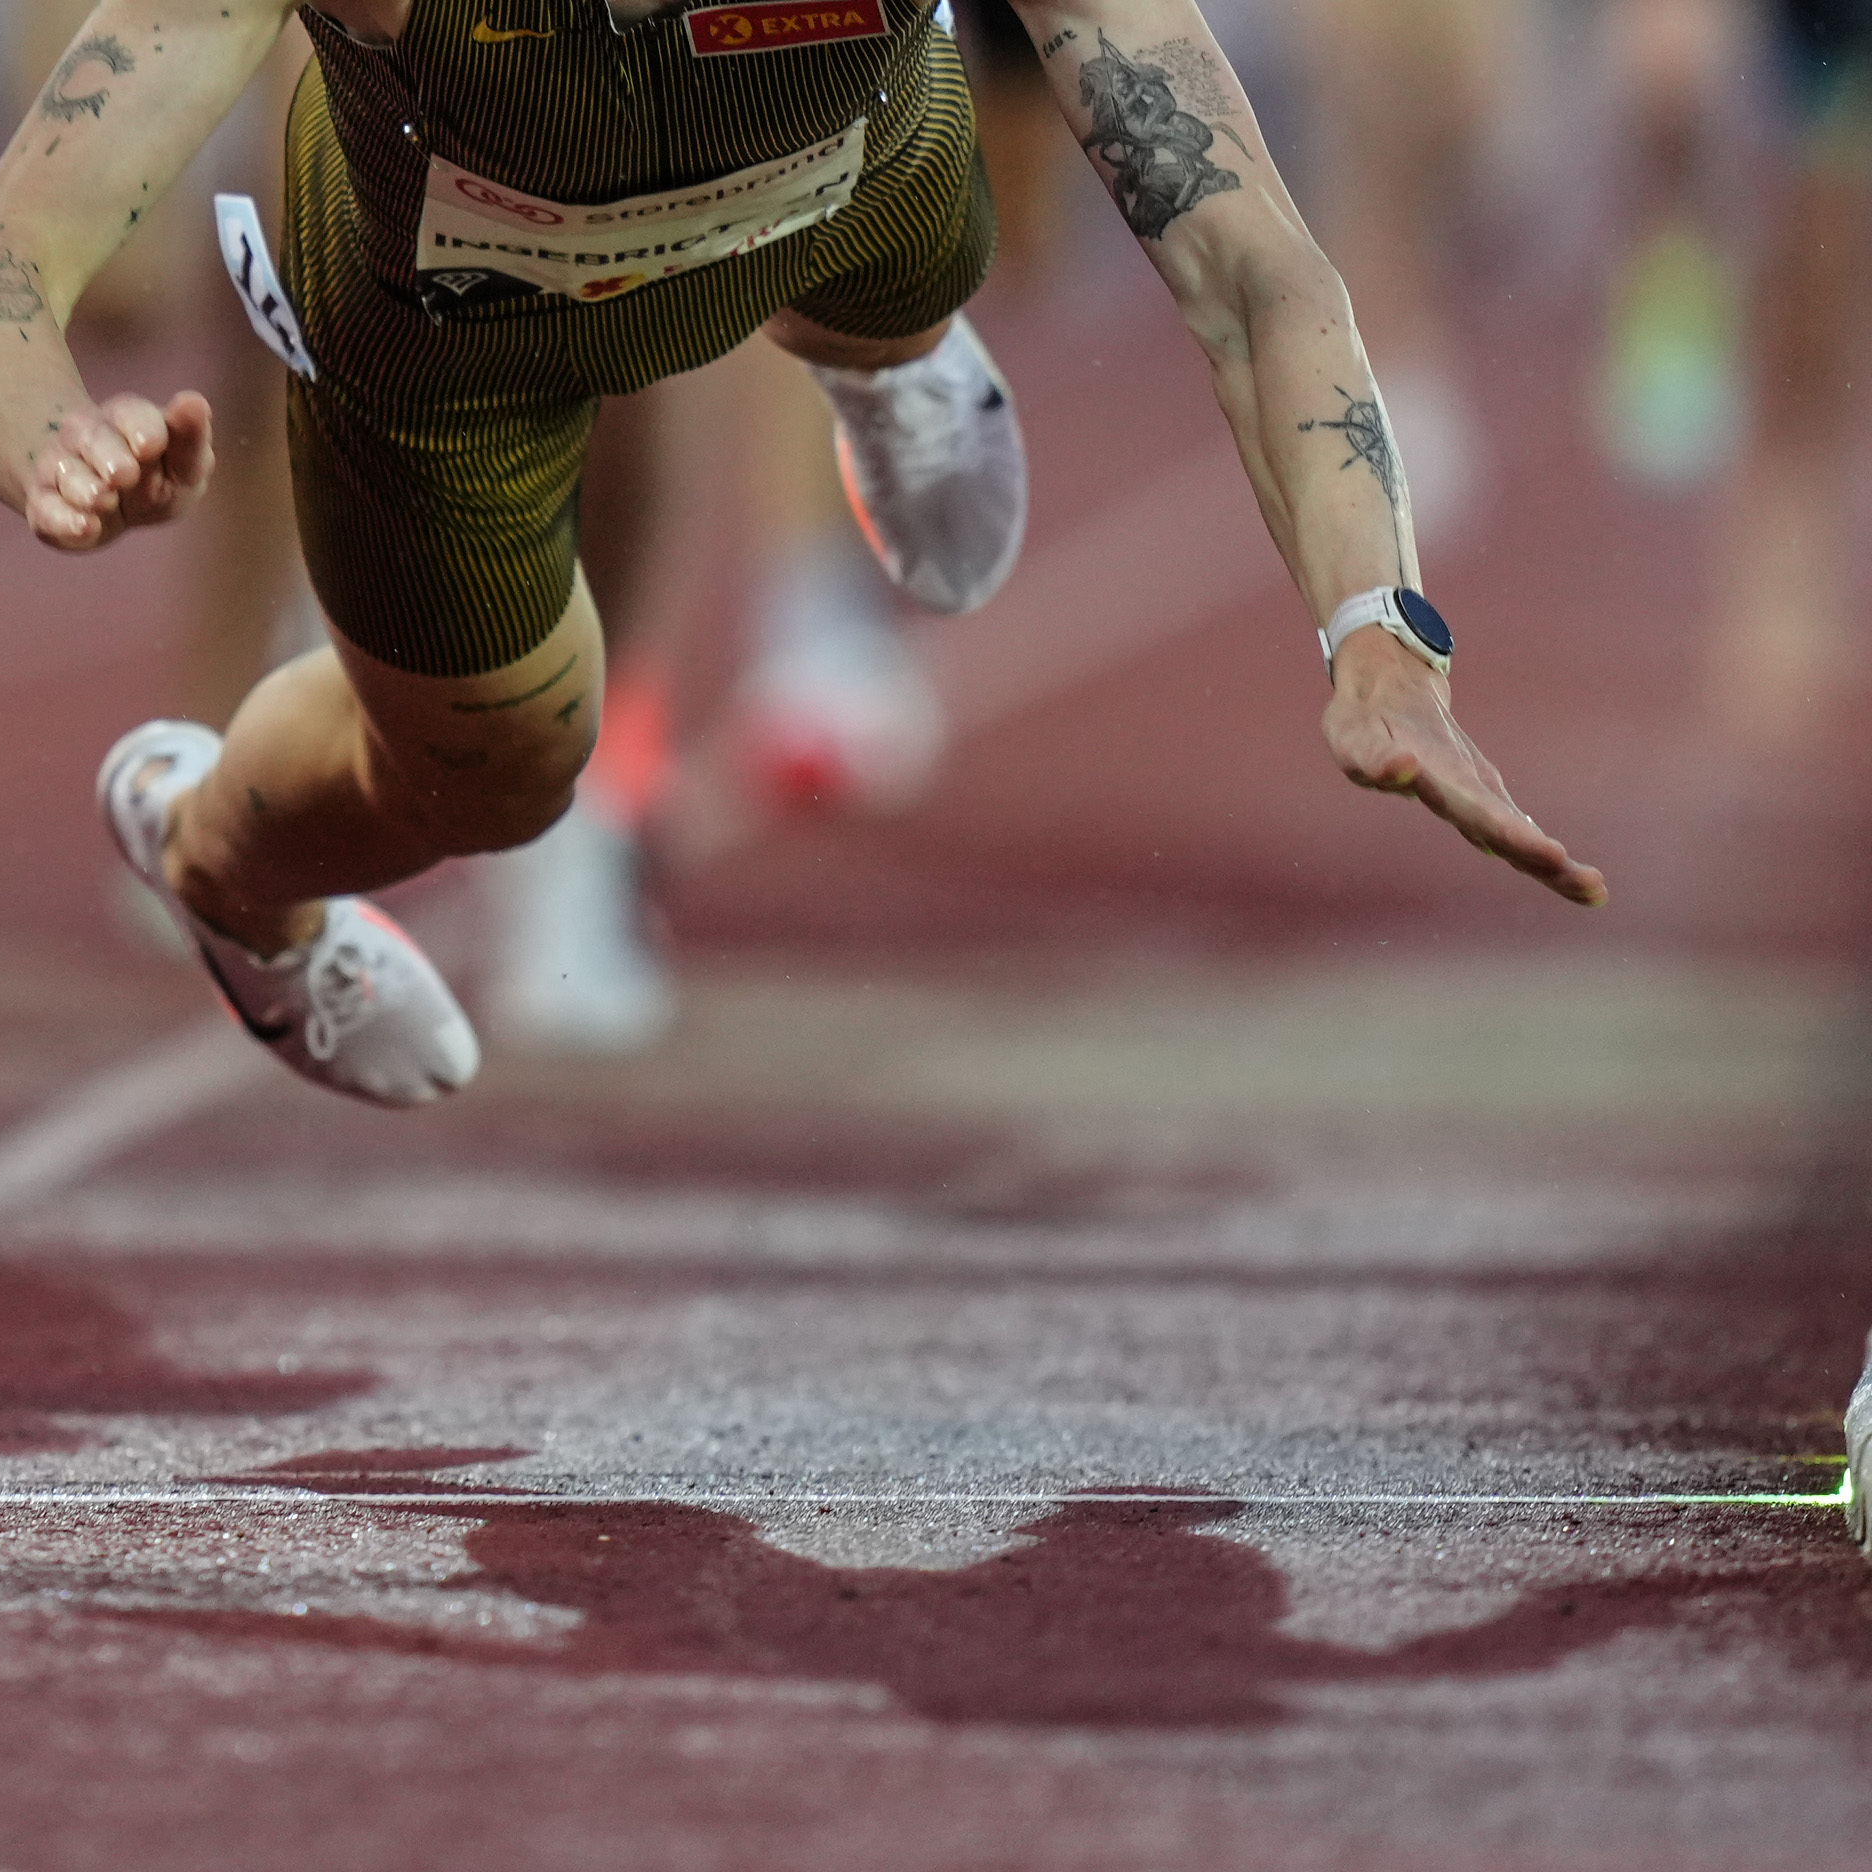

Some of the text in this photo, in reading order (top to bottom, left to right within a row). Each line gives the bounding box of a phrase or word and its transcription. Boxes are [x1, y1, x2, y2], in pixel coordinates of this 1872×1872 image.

[761, 9, 866, 36] EXTRA
[434, 171, 850, 267] INGEBRIGTN
[584, 136, 845, 225] Storebrand
